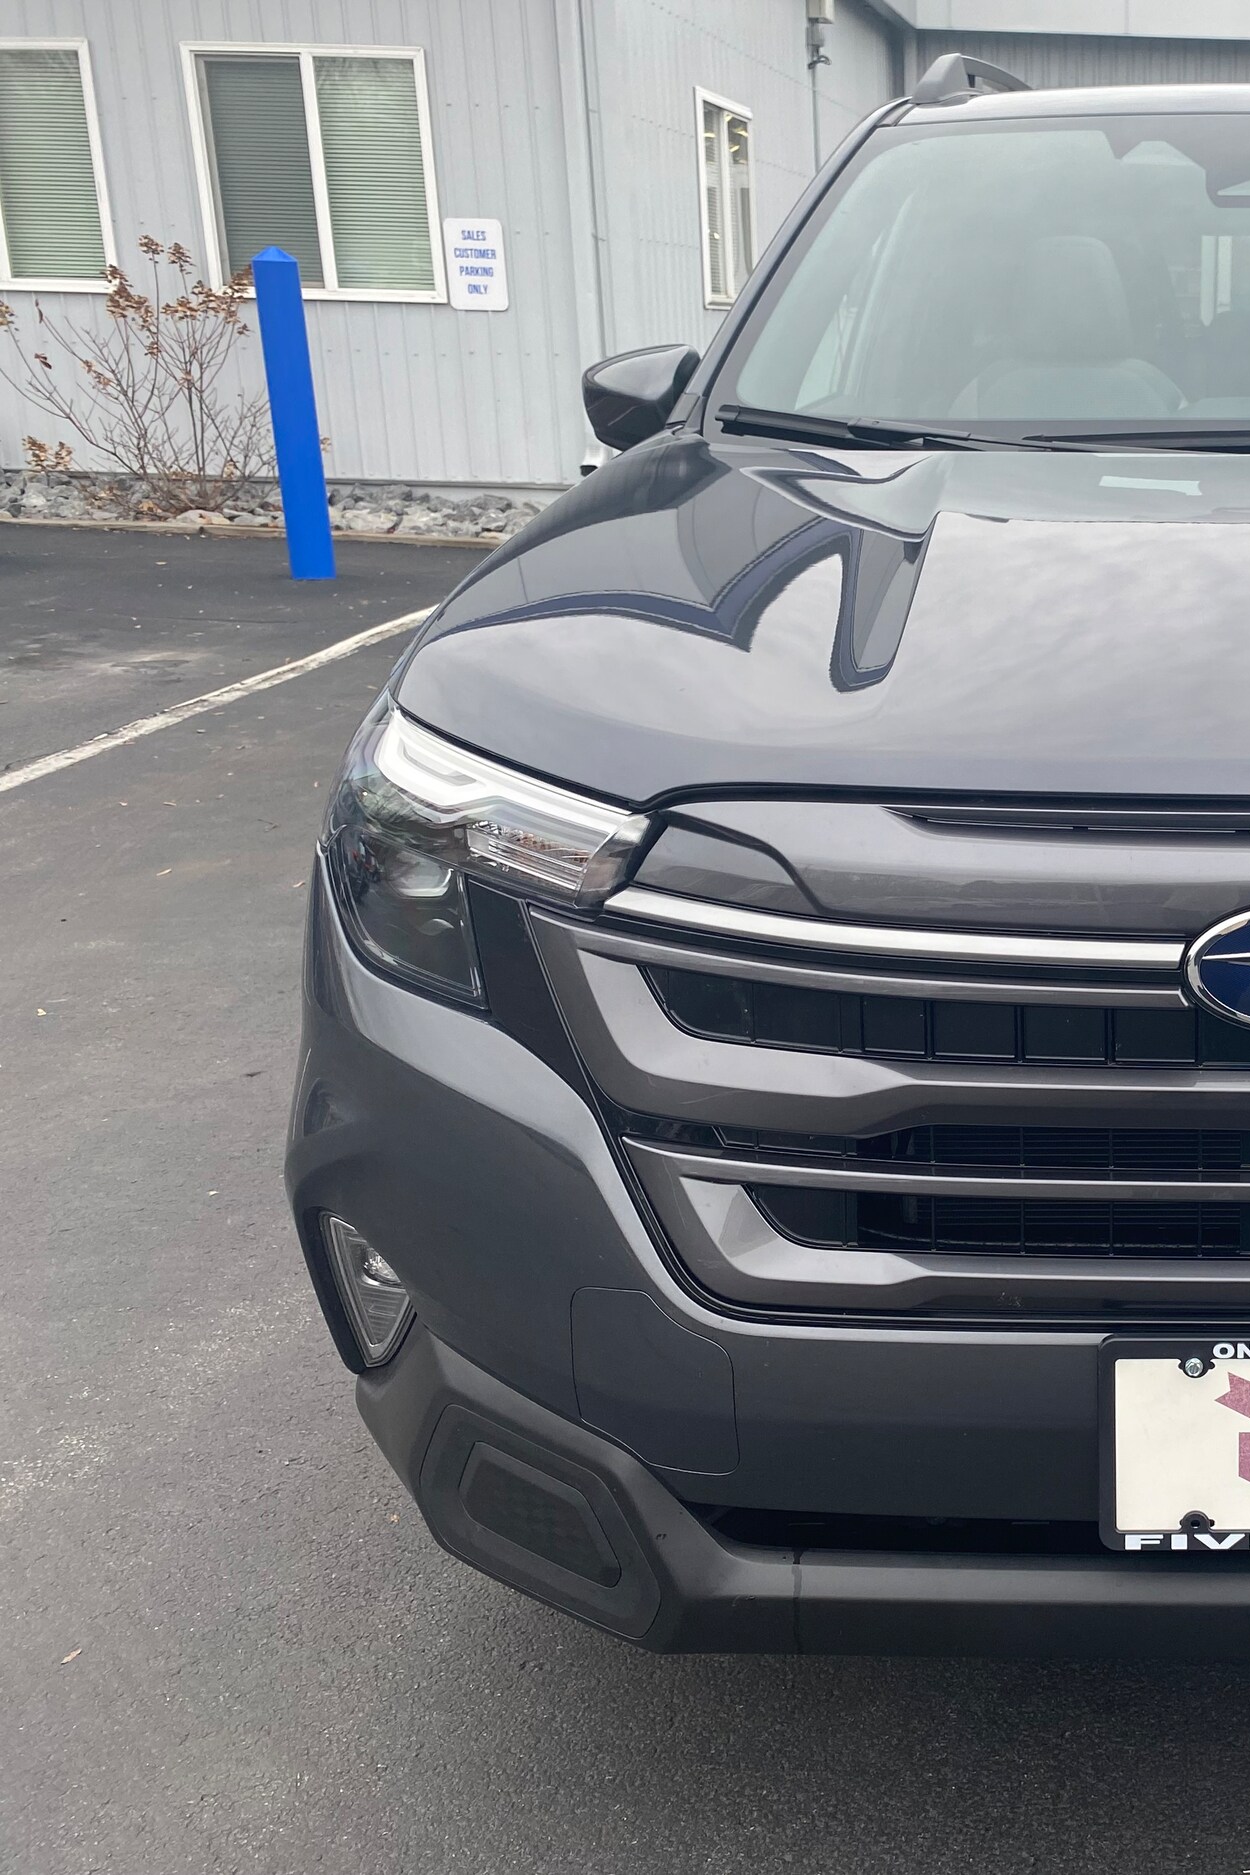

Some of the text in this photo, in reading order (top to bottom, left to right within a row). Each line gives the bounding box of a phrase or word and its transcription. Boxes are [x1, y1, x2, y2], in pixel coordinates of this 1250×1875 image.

[461, 230, 486, 241] SALES
[454, 248, 496, 259] CUSTOMER
[460, 266, 494, 277] PARKING
[467, 284, 488, 295] ONLY
